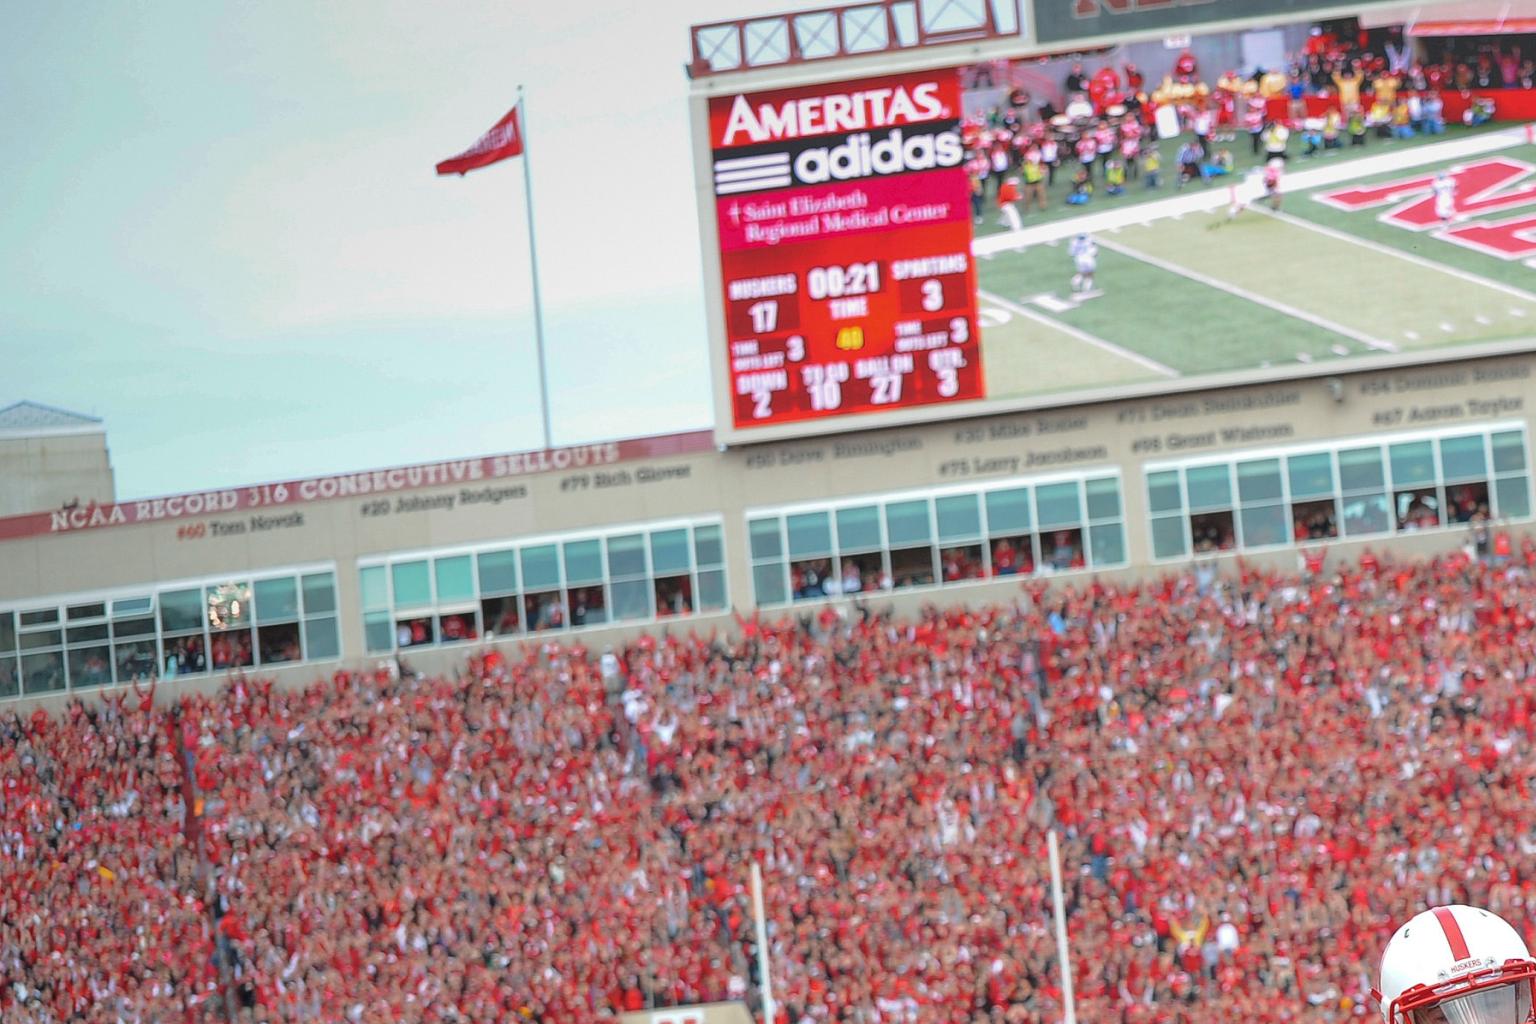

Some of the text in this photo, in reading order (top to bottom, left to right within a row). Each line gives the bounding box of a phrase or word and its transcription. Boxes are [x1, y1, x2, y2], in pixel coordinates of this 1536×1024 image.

[723, 82, 946, 146] AMERITAS
[794, 128, 963, 184] adidas
[742, 189, 868, 222] Saint Elizabeth
[745, 203, 949, 244] Regional Medical Center
[807, 261, 880, 300] 00:21
[748, 278, 944, 334] 17 3
[786, 335, 806, 362] 3
[950, 317, 969, 344] 3
[751, 369, 959, 419] 2 10 27 3
[51, 503, 127, 532] NCAA
[136, 490, 238, 522] RECORD
[299, 459, 484, 499] CONSECUTIVE
[492, 443, 620, 478] SELLOUTS
[210, 519, 246, 538] Tom
[251, 511, 305, 531] Novak
[1450, 959, 1482, 973] HUSKERS
